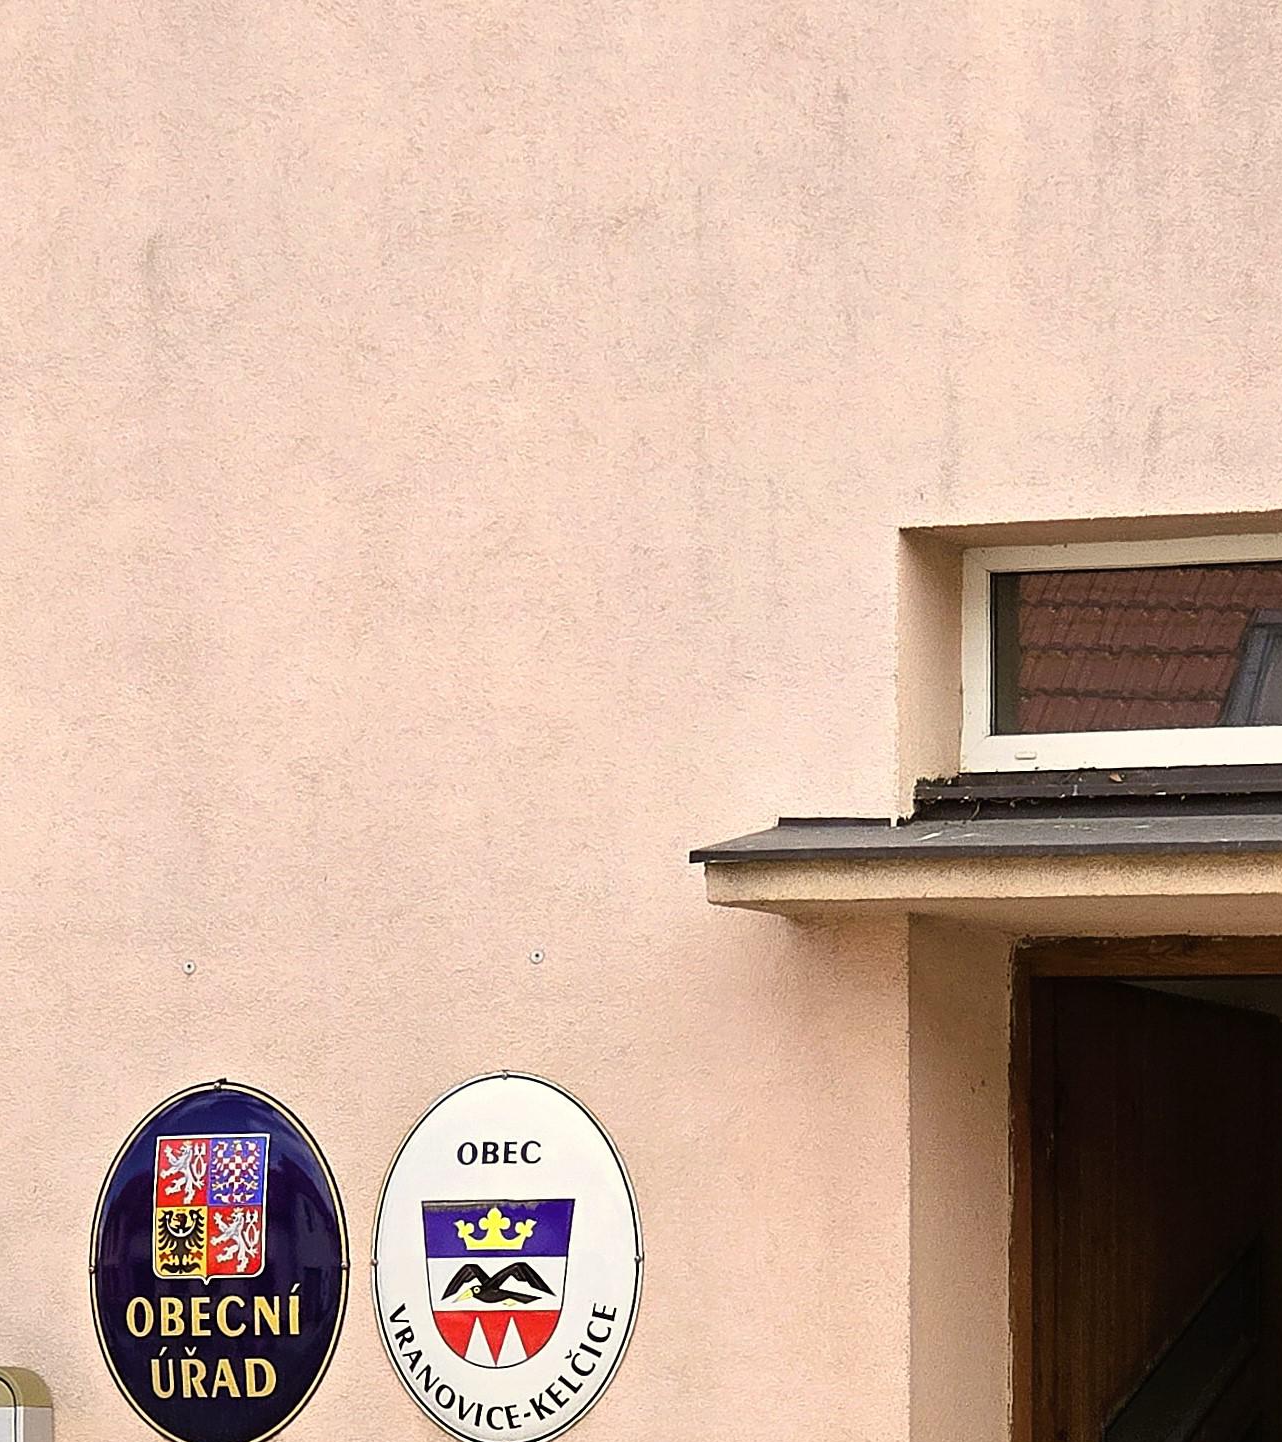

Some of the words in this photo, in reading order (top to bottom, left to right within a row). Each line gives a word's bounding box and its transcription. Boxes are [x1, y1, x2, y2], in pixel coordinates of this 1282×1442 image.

[458, 1140, 542, 1165] OBEC
[126, 1283, 301, 1338] OBECNÍ
[151, 1347, 277, 1399] ÚŘAD
[389, 1302, 616, 1431] VRANOVICE-KELČICE
